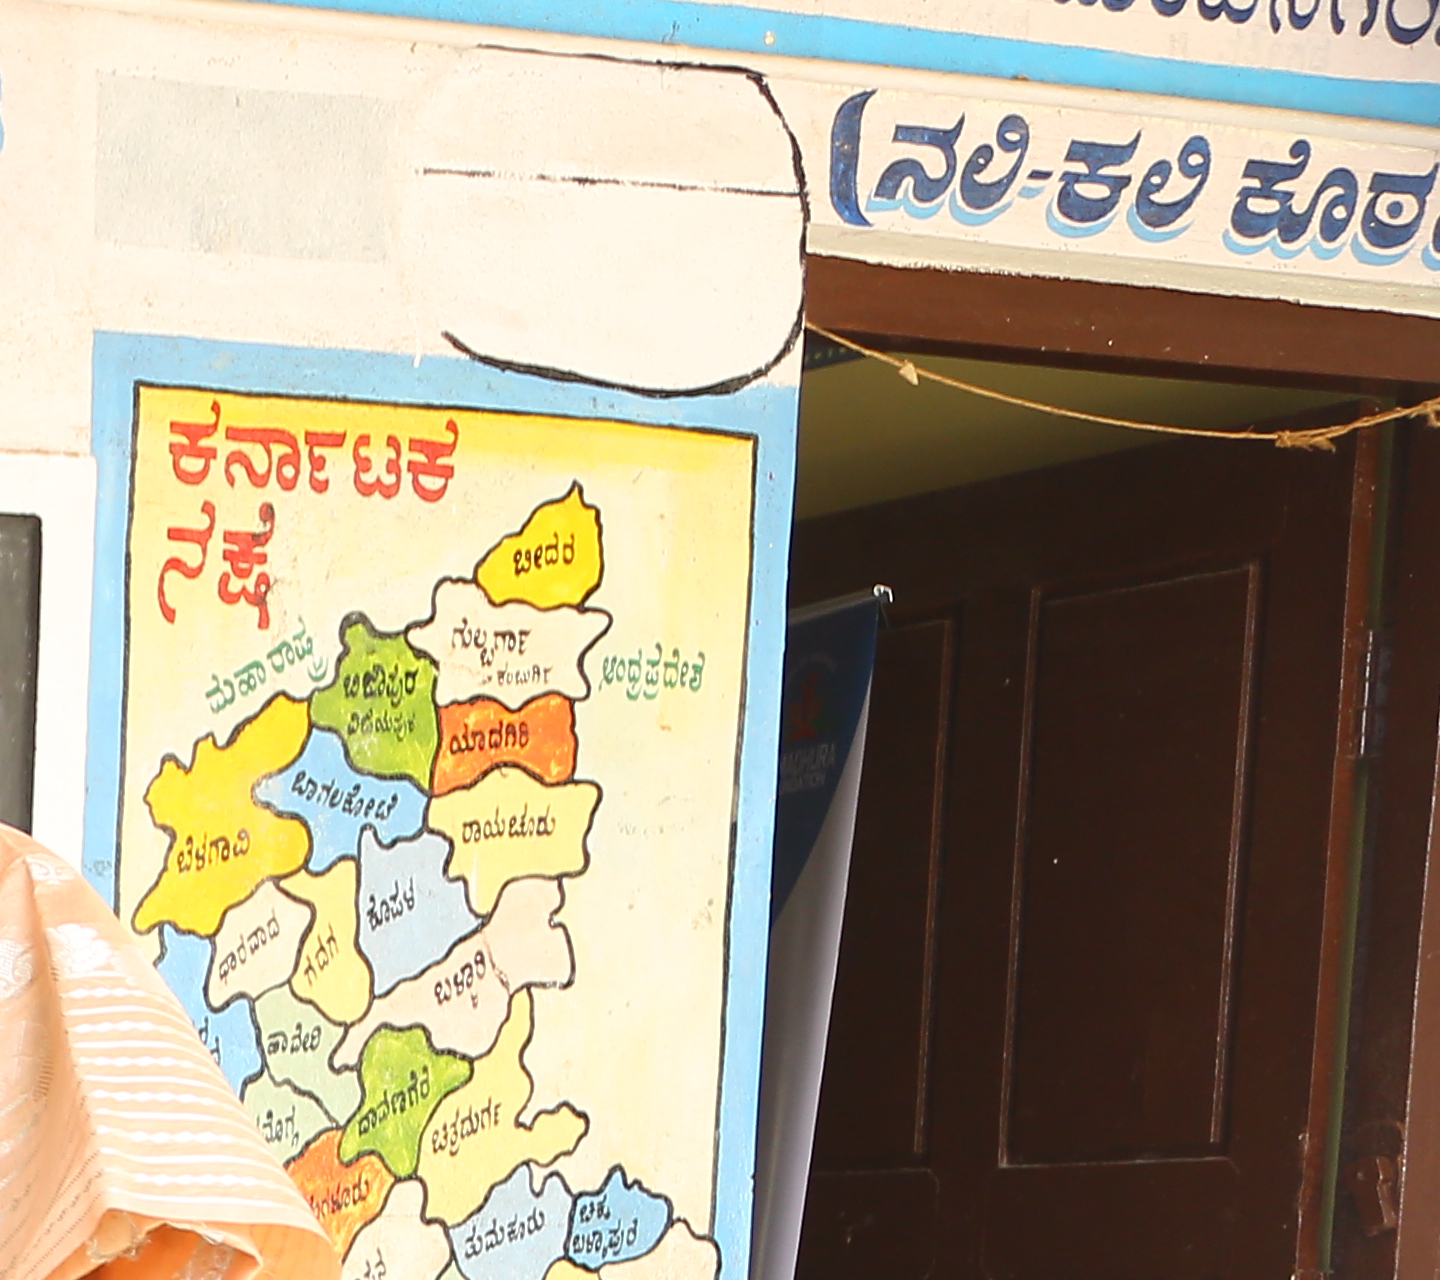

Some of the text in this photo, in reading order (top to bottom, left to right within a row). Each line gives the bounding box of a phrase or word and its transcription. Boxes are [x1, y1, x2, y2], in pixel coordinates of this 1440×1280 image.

[1230, 139, 1440, 250] ಕೊಠ
[169, 400, 459, 503] ಕರ್ನಾಟಕ
[157, 499, 276, 631] ನಕ್ಷೆ
